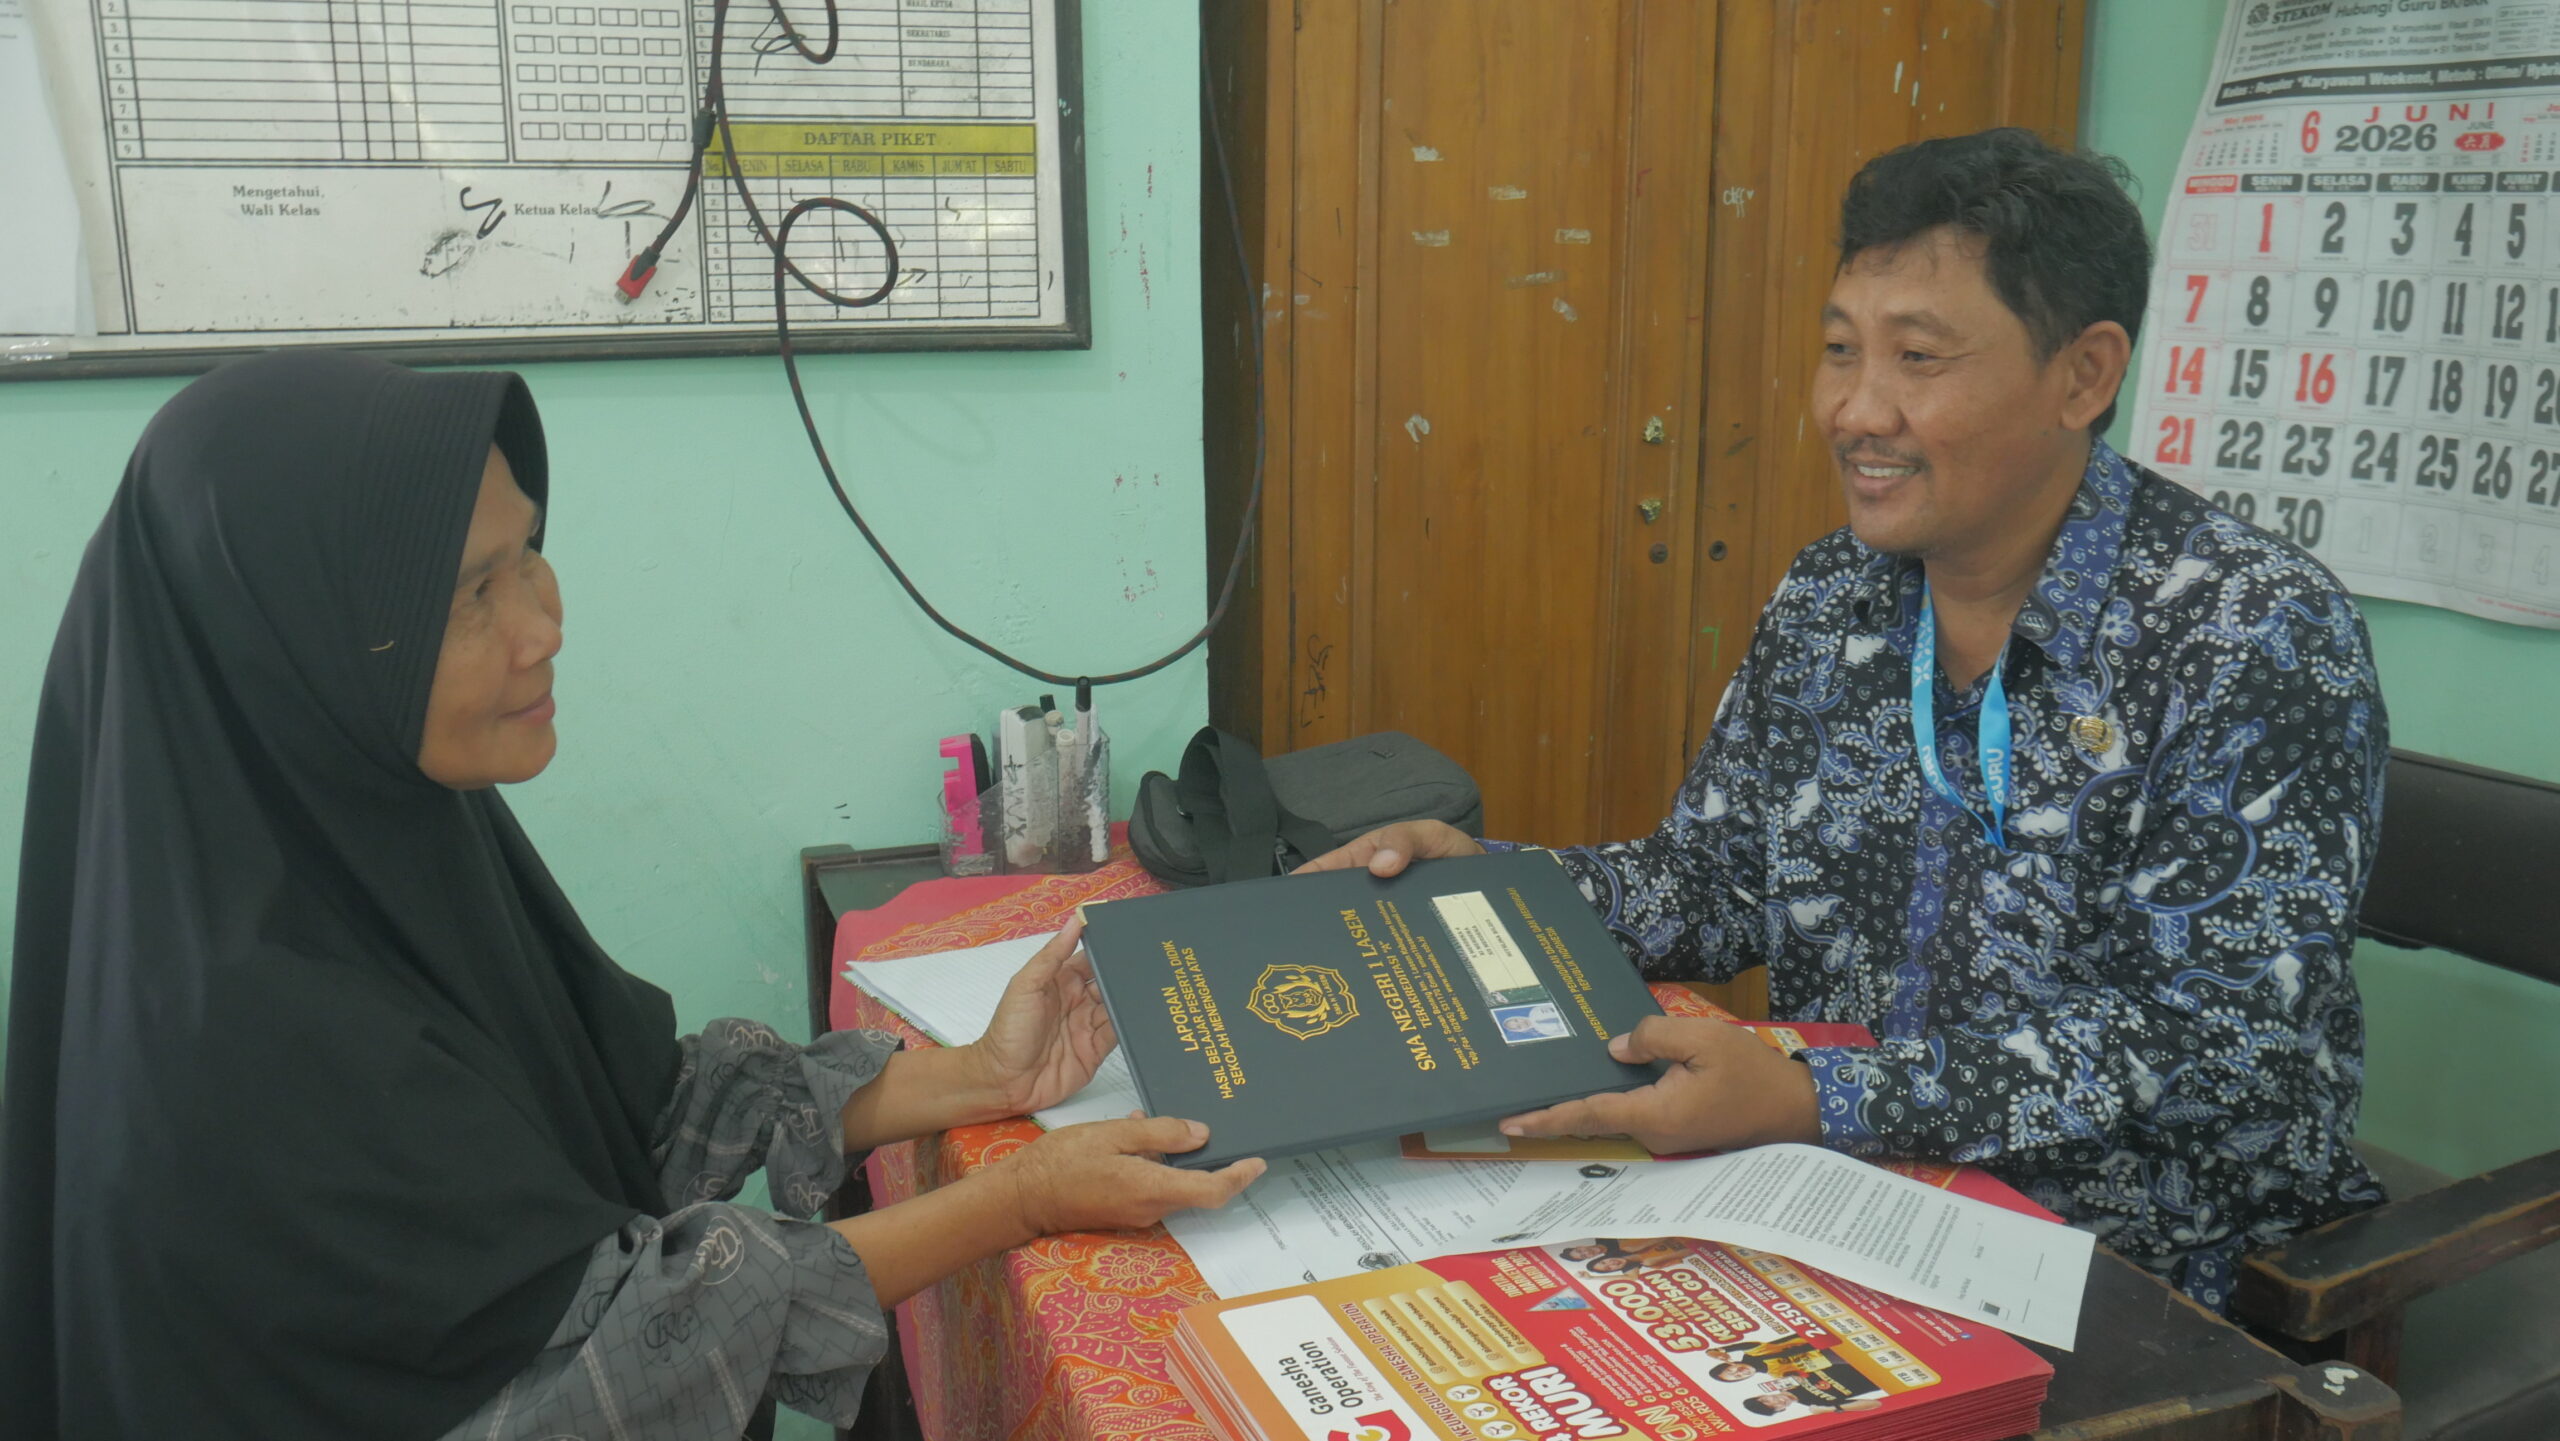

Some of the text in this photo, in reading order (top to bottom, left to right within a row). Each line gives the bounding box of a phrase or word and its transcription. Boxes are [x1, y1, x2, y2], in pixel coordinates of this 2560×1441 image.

[2272, 2, 2333, 24] STEKOM
[2399, 0, 2438, 12] Guru
[2301, 109, 2321, 154] 6
[2363, 101, 2495, 124] JUNI
[2467, 121, 2495, 130] JUNE
[804, 132, 936, 146] DAFTAR PIKET
[2334, 123, 2438, 153] 2026
[2463, 134, 2492, 149] 六月
[785, 159, 824, 172] SELASA
[843, 159, 871, 172] RABU
[893, 160, 925, 172] KAMIS
[995, 160, 1026, 173] SABTU
[2251, 175, 2293, 186] SENIN
[2313, 175, 2367, 186] SELASA
[2389, 175, 2429, 186] RABU
[2450, 174, 2486, 185] KAMIS
[240, 203, 321, 216] Wali Kelas
[514, 203, 556, 216] Ketua
[2259, 201, 2527, 260] 1 2 3 4 5
[2186, 275, 2526, 340] 7 8 9 10 11 12
[2165, 346, 2518, 420] 14 15 16 17 18 19
[2155, 415, 2513, 500] 21 22 23 24 25 26
[2273, 497, 2324, 549] 30
[1923, 745, 1948, 796] GURU
[1986, 749, 2005, 804] GURU
[1535, 932, 1555, 955] DASAR
[1543, 925, 1592, 991] REPUBLIK INDONESIA
[1339, 908, 1437, 1071] SMA NEGERI 1 LASEM
[1387, 954, 1433, 1027] TERAKREDITASI
[1548, 953, 1579, 993] PENDIDIKAN
[1161, 985, 1199, 1052] LAPORAN
[1161, 940, 1234, 1098] HASIL BELAJAR PESERTA DIDIK
[1181, 947, 1247, 1085] SEKOLAH MENENGAH ATAS
[1423, 990, 1442, 1013] Bonang
[1450, 996, 1469, 1020] Website
[1572, 992, 1610, 1040] KEMENTERIAN
[1436, 1014, 1452, 1034] Sunan
[1489, 1272, 1523, 1297] DIGITAL
[1491, 1256, 1540, 1293] MARKETING
[1521, 1264, 1556, 1290] AWARD
[1714, 1249, 1779, 1299] KE KEDOKTERAN
[1448, 1310, 1469, 1328] Belajar
[1605, 1279, 1701, 1353] 53.000
[1644, 1271, 1736, 1342] KELULUSAN
[1658, 1298, 1688, 1320] LEBIH
[1671, 1268, 1753, 1331] SISWA GO
[1770, 1299, 1827, 1338] 2.550
[1393, 1323, 1415, 1342] Belajar
[1403, 1299, 1465, 1360] Bimbingan Belajar Terbesar
[1463, 1325, 1492, 1353] Bimbingan
[1339, 1300, 1471, 1438] KEUNGGULAN GANESHA OPERATION
[1409, 1339, 1437, 1367] Bimbingan
[1278, 1354, 1335, 1416] Ganesha
[1299, 1341, 1364, 1409] Operation
[1489, 1375, 1561, 1432] REKOR
[1519, 1366, 1623, 1438] MURI
[1672, 1399, 1717, 1438] Indonesia
[1684, 1395, 1736, 1433] AWARDS
